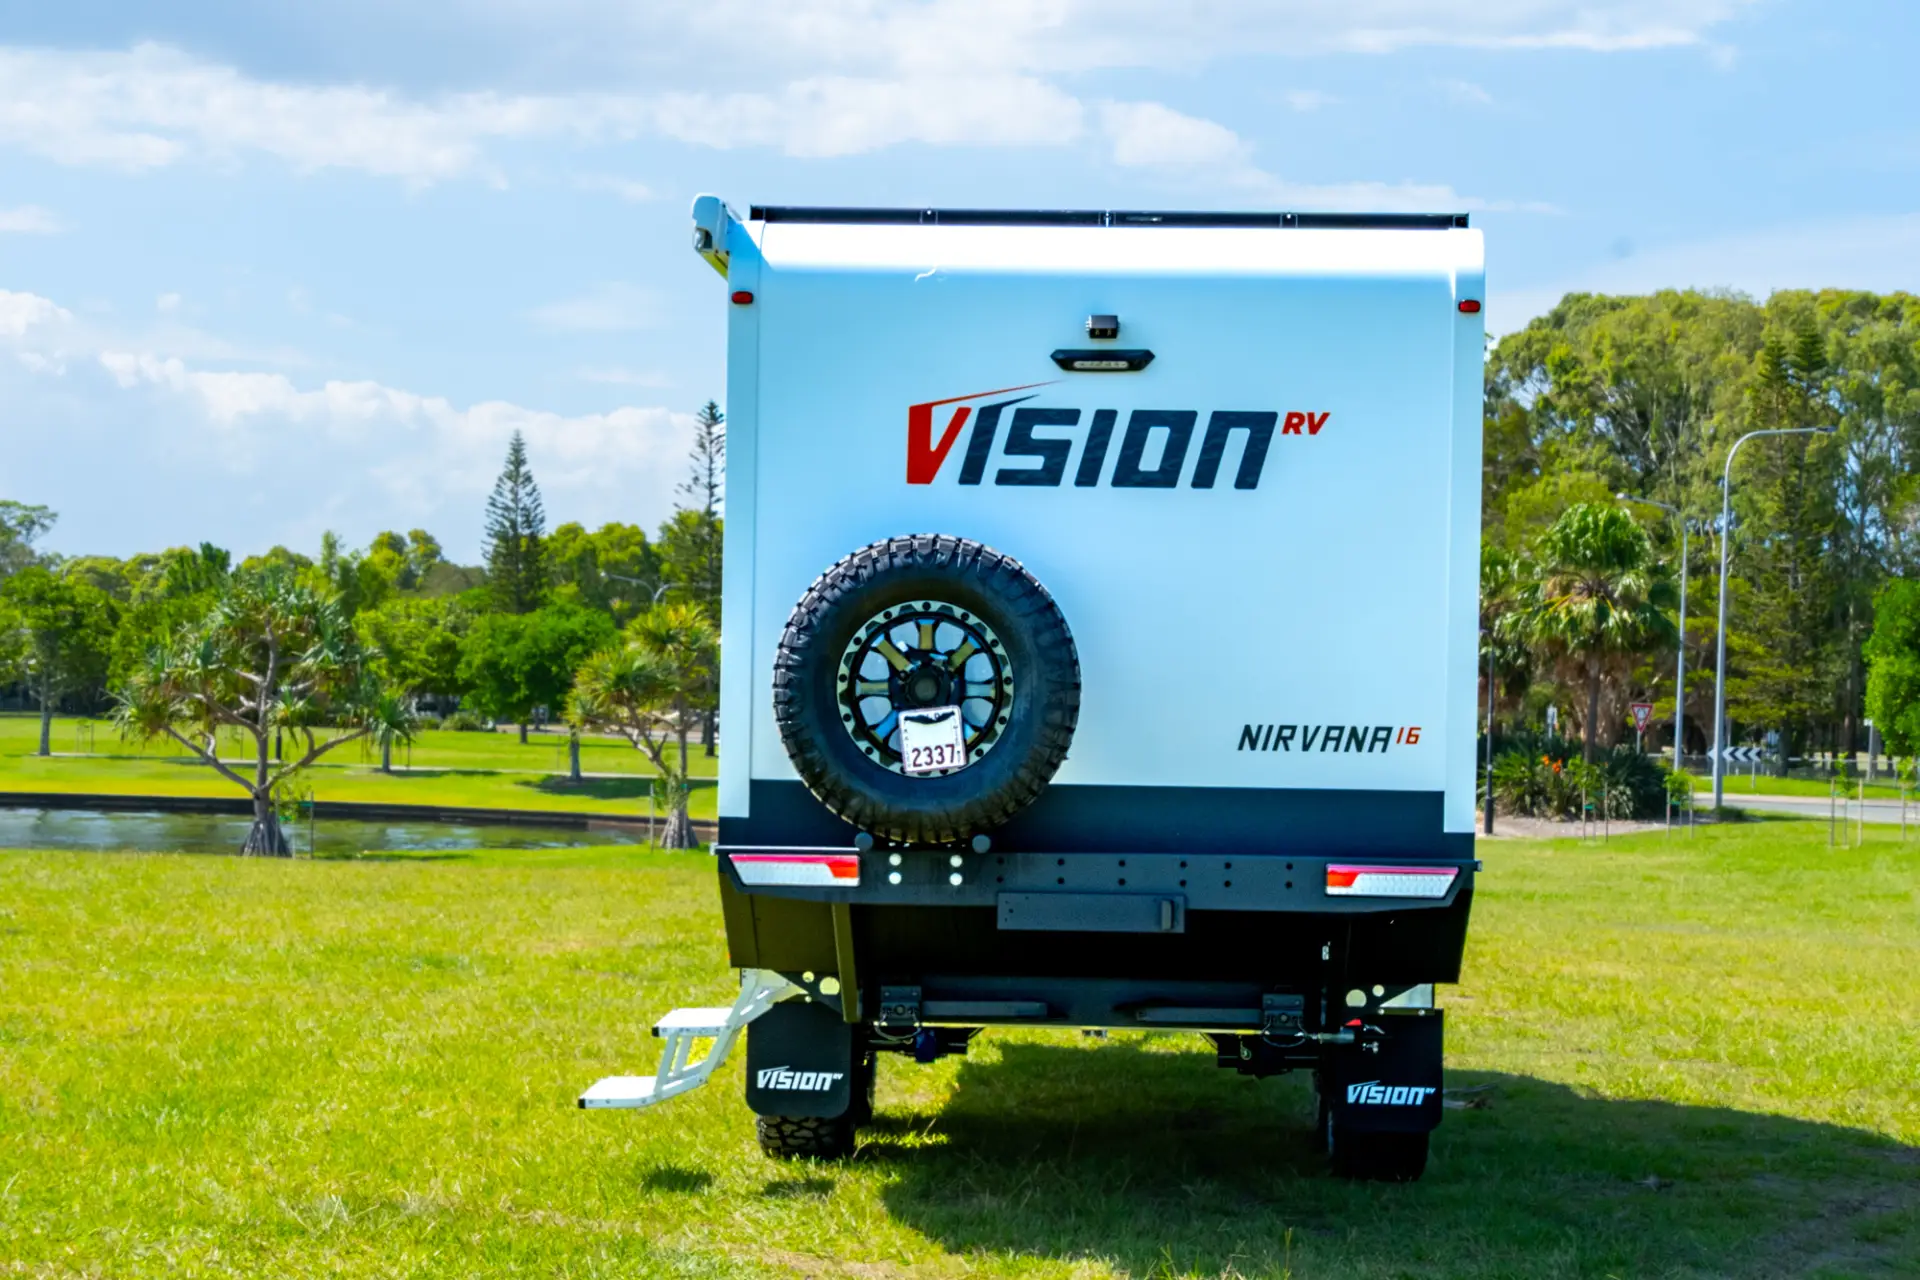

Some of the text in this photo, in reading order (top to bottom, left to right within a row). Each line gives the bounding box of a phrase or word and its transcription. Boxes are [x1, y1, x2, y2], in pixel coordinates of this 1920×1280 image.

[1281, 411, 1331, 435] RV
[1238, 724, 1422, 753] NIRVANA 16
[911, 743, 955, 768] 2337
